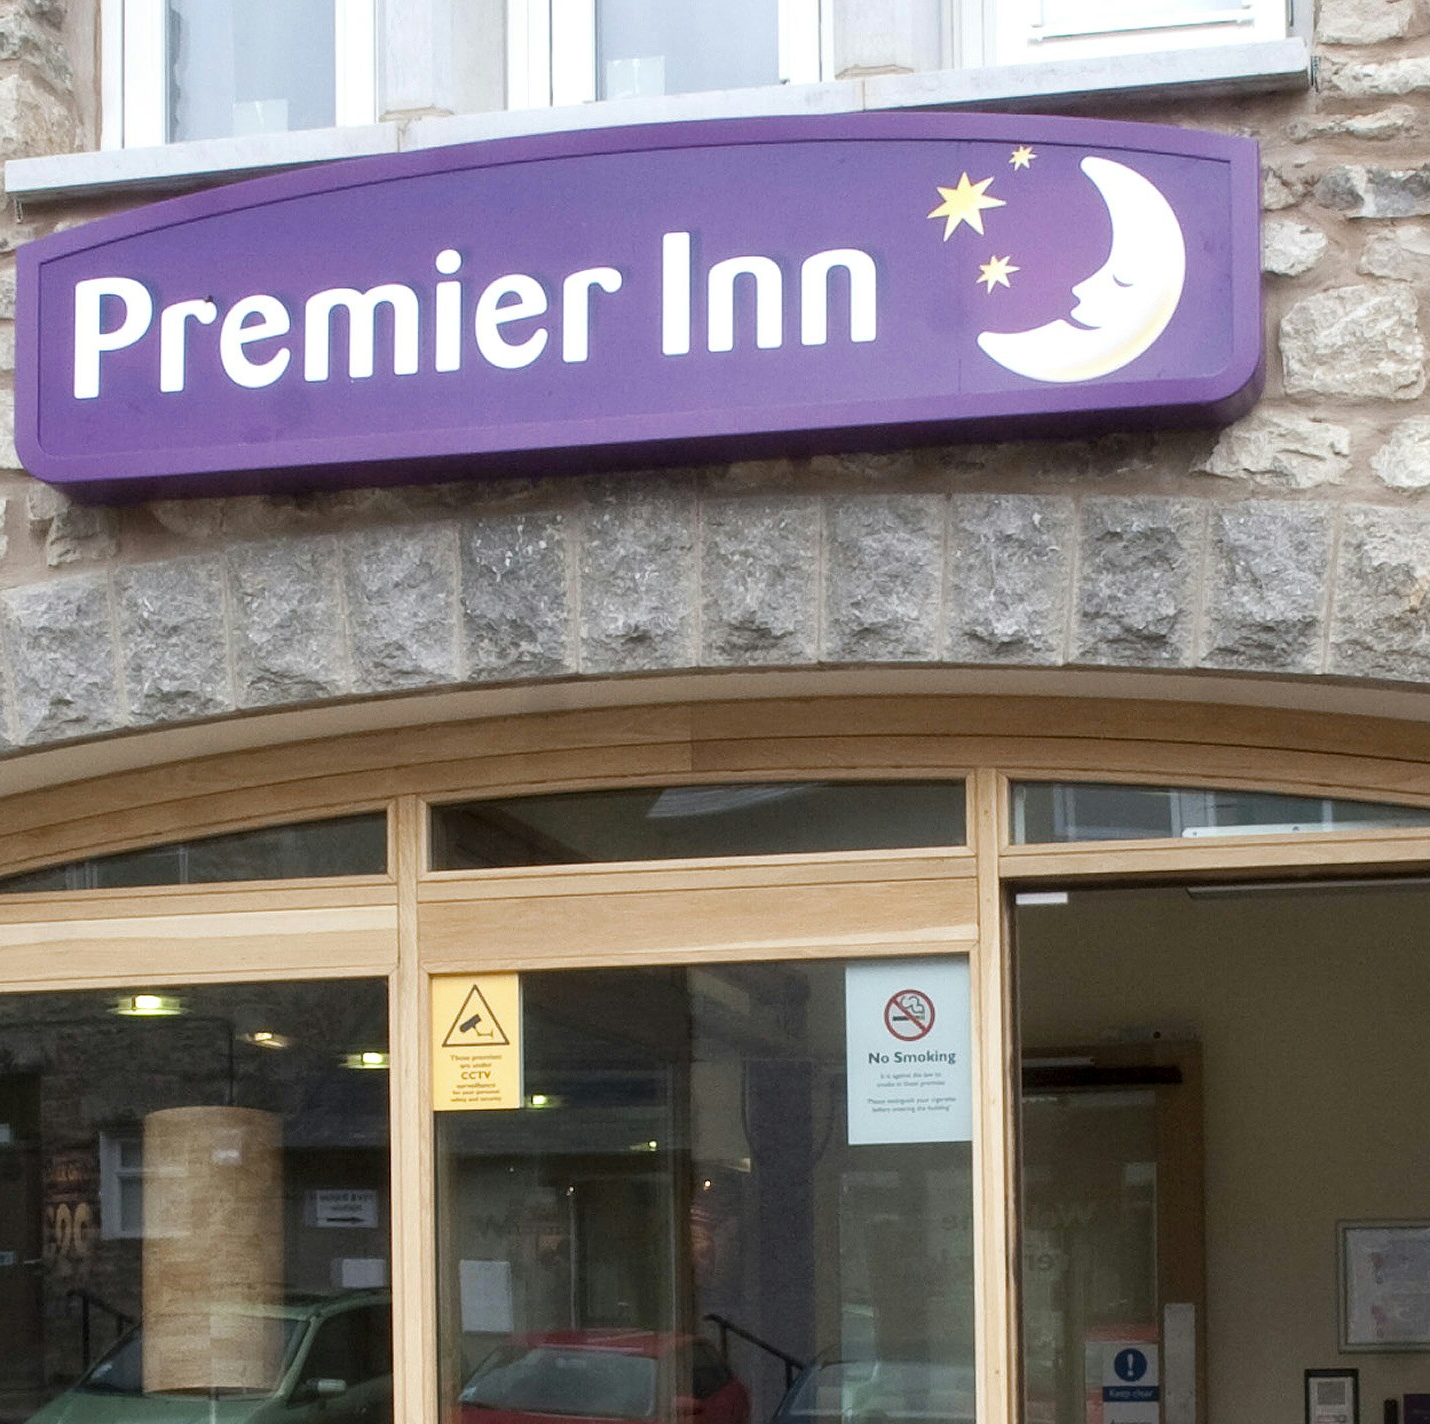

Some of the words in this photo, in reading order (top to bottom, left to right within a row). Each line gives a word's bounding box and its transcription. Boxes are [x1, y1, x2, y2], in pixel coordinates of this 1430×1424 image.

[72, 248, 623, 401] Premier
[662, 231, 877, 356] Inn
[867, 1051, 890, 1065] No
[894, 1049, 957, 1066] Smoking
[460, 1070, 492, 1080] CCTV
